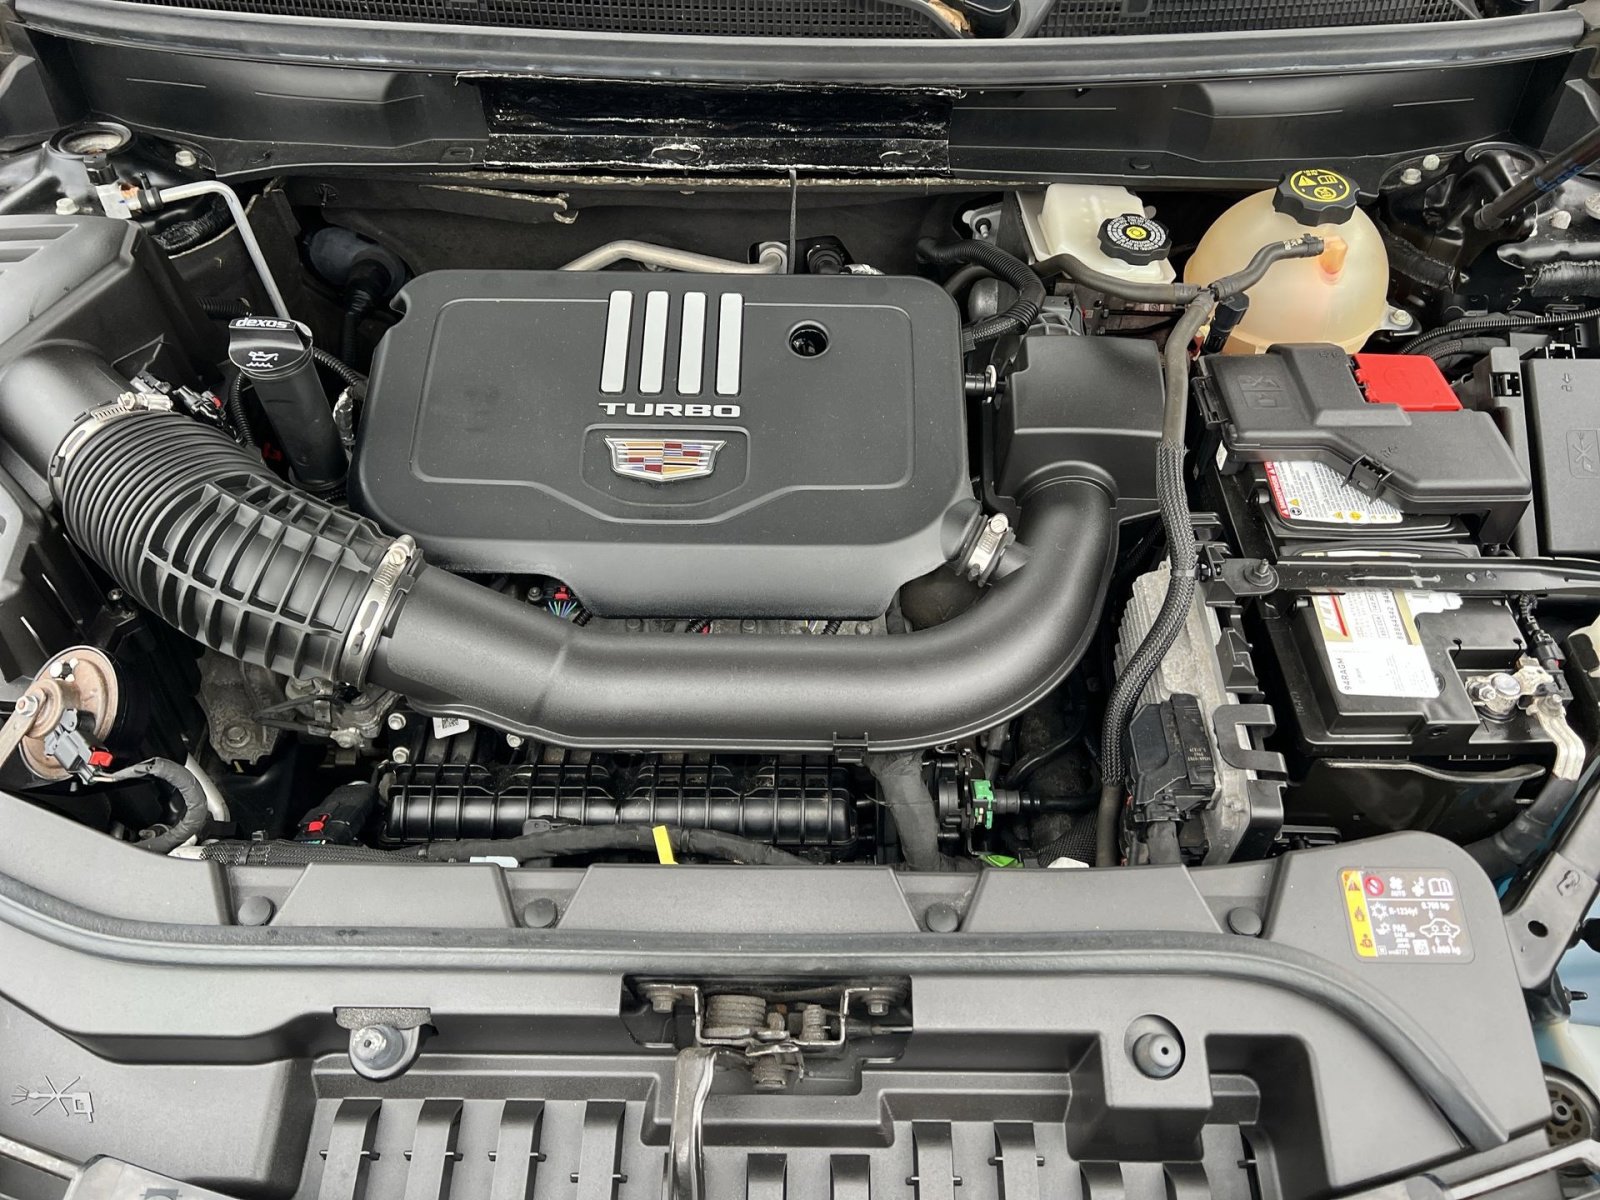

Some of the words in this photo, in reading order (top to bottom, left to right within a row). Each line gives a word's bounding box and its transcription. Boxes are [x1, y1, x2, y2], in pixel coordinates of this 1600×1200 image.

[236, 317, 290, 328] dexos
[598, 402, 740, 417] TURBO
[1335, 658, 1352, 690] 94RAGM
